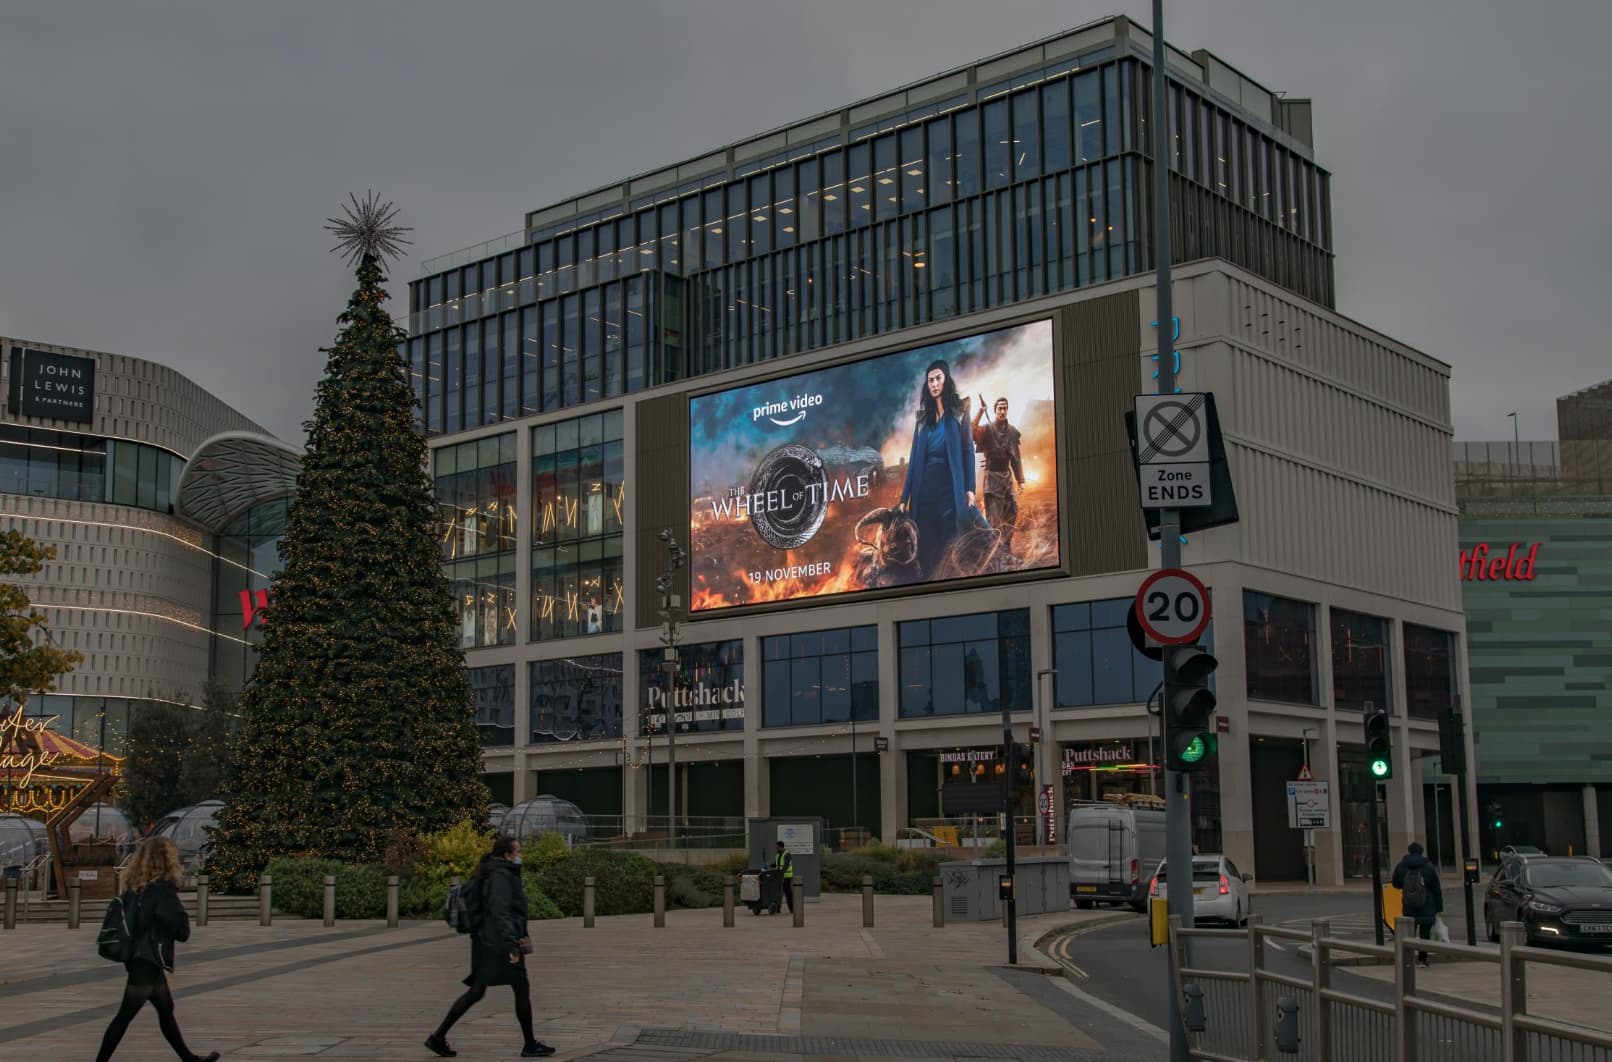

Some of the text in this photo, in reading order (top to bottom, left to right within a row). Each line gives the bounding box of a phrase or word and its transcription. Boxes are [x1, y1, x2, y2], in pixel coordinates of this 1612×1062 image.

[39, 364, 81, 378] JOHN
[34, 379, 85, 395] LEWIS
[42, 397, 84, 408] PARTNERS
[753, 393, 823, 421] prime video
[1158, 470, 1193, 481] Zone
[712, 474, 869, 520] WHEEL OF TIME
[728, 486, 745, 497] THE
[1148, 484, 1204, 501] ENDS
[749, 562, 831, 584] 19 NOVEMBER
[1148, 591, 1199, 622] 20
[1064, 745, 1132, 762] Puttshack
[0, 738, 59, 789] age
[1040, 798, 1047, 808] 20
[1047, 786, 1055, 842] Puttshack
